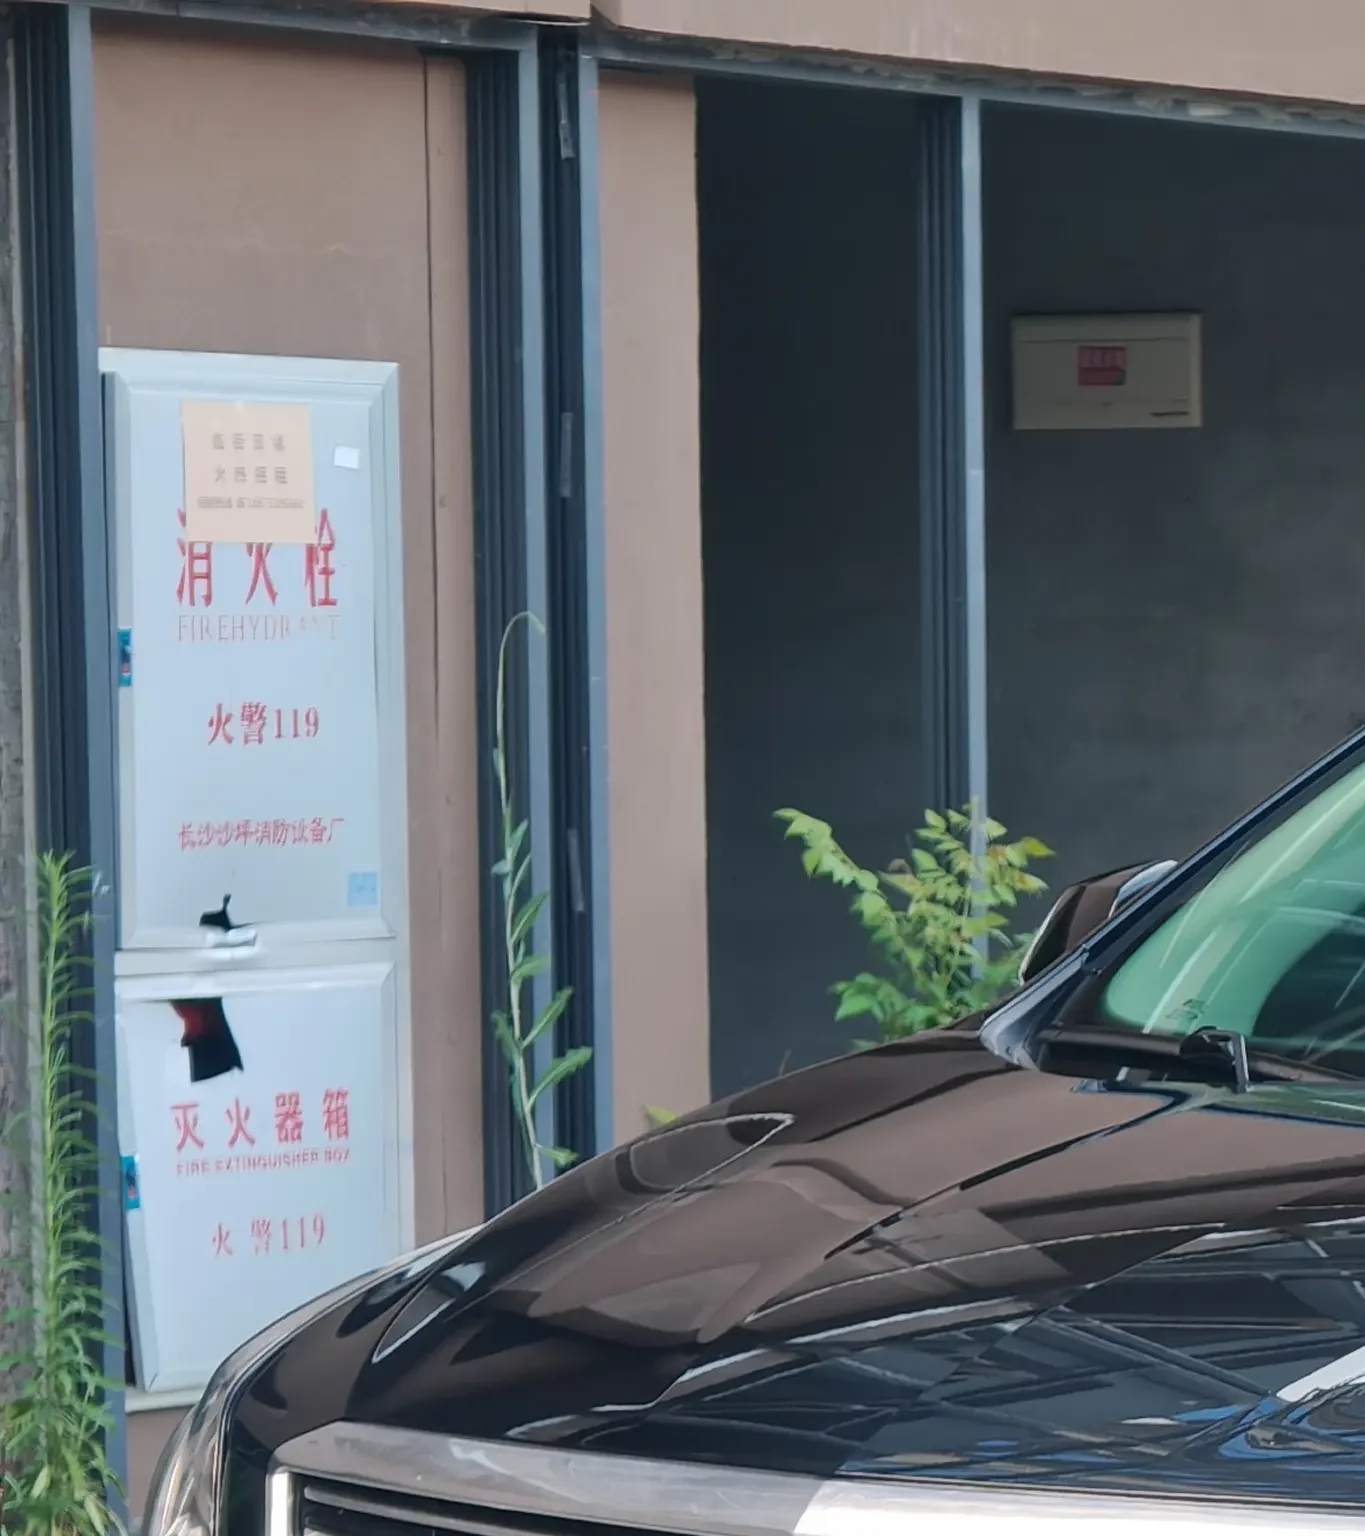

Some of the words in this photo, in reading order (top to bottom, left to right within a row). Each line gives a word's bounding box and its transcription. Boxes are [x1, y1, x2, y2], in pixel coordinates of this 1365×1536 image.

[176, 507, 337, 607] 消火栓
[178, 614, 341, 642] FIREHYDRT
[207, 702, 320, 747] 火警119
[170, 1087, 349, 1151] 灭火器箱
[176, 1160, 209, 1177] FIRE
[215, 1150, 319, 1173] EXTINGUISHER
[212, 1212, 325, 1257] 火警119
